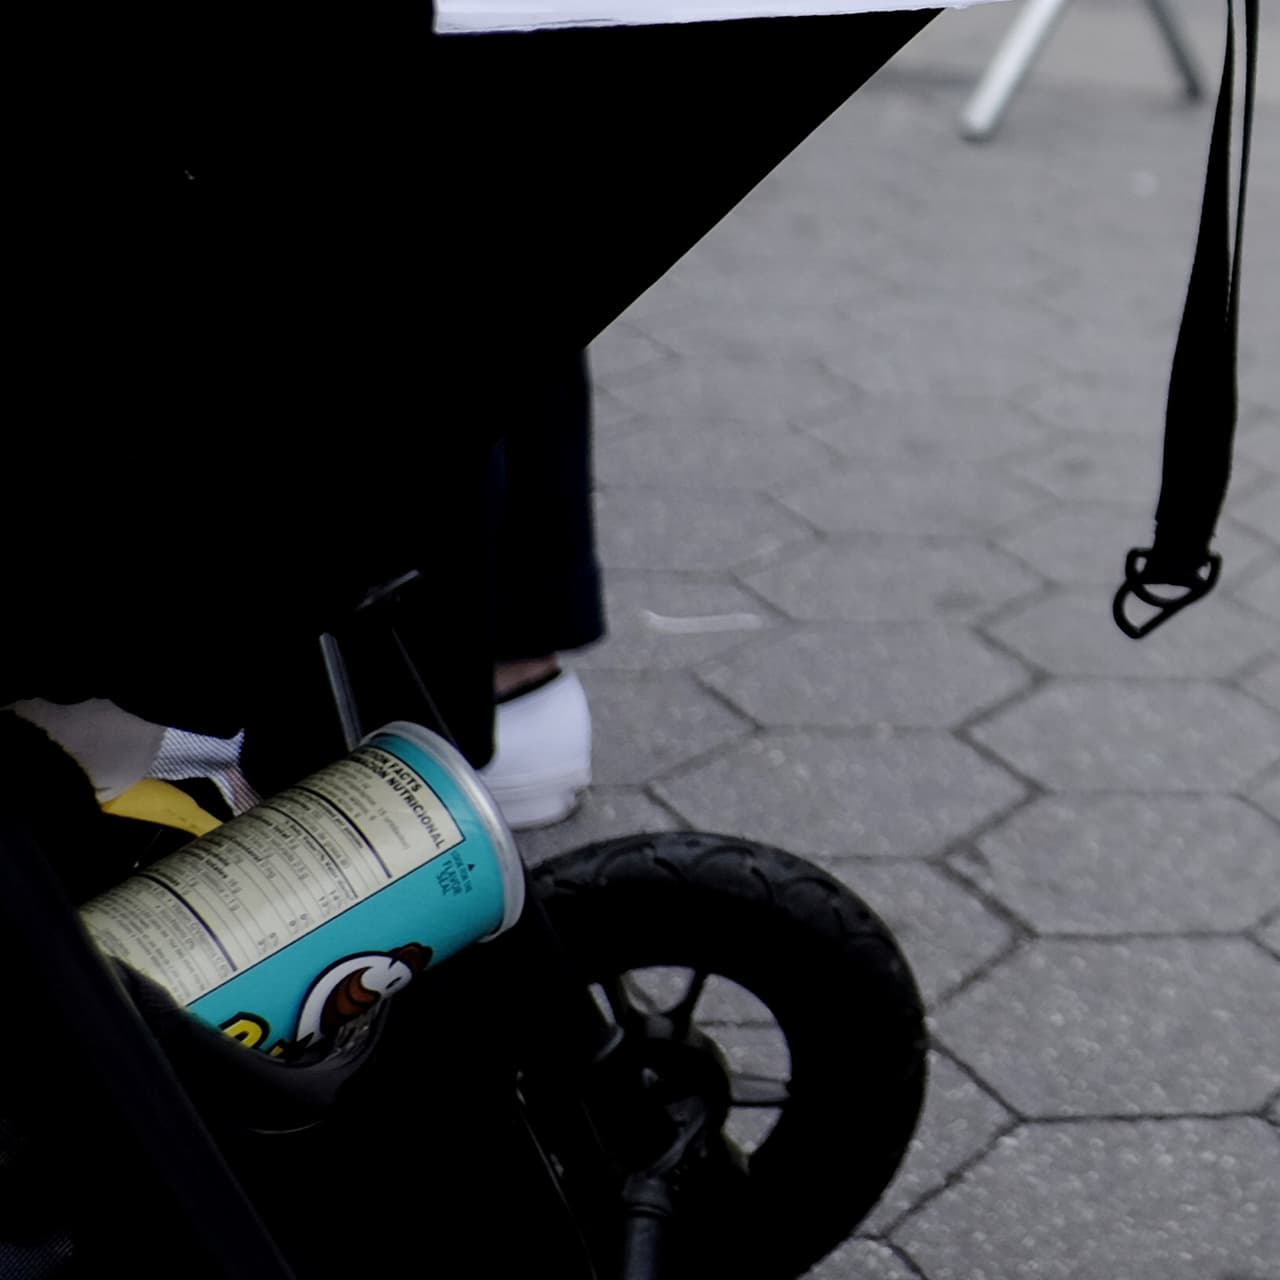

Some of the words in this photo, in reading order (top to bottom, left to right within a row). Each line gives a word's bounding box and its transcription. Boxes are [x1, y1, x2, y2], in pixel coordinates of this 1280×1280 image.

[388, 761, 423, 793] FACTS
[386, 776, 446, 849] NUTRICIONAL
[442, 859, 462, 896] FLAVOR
